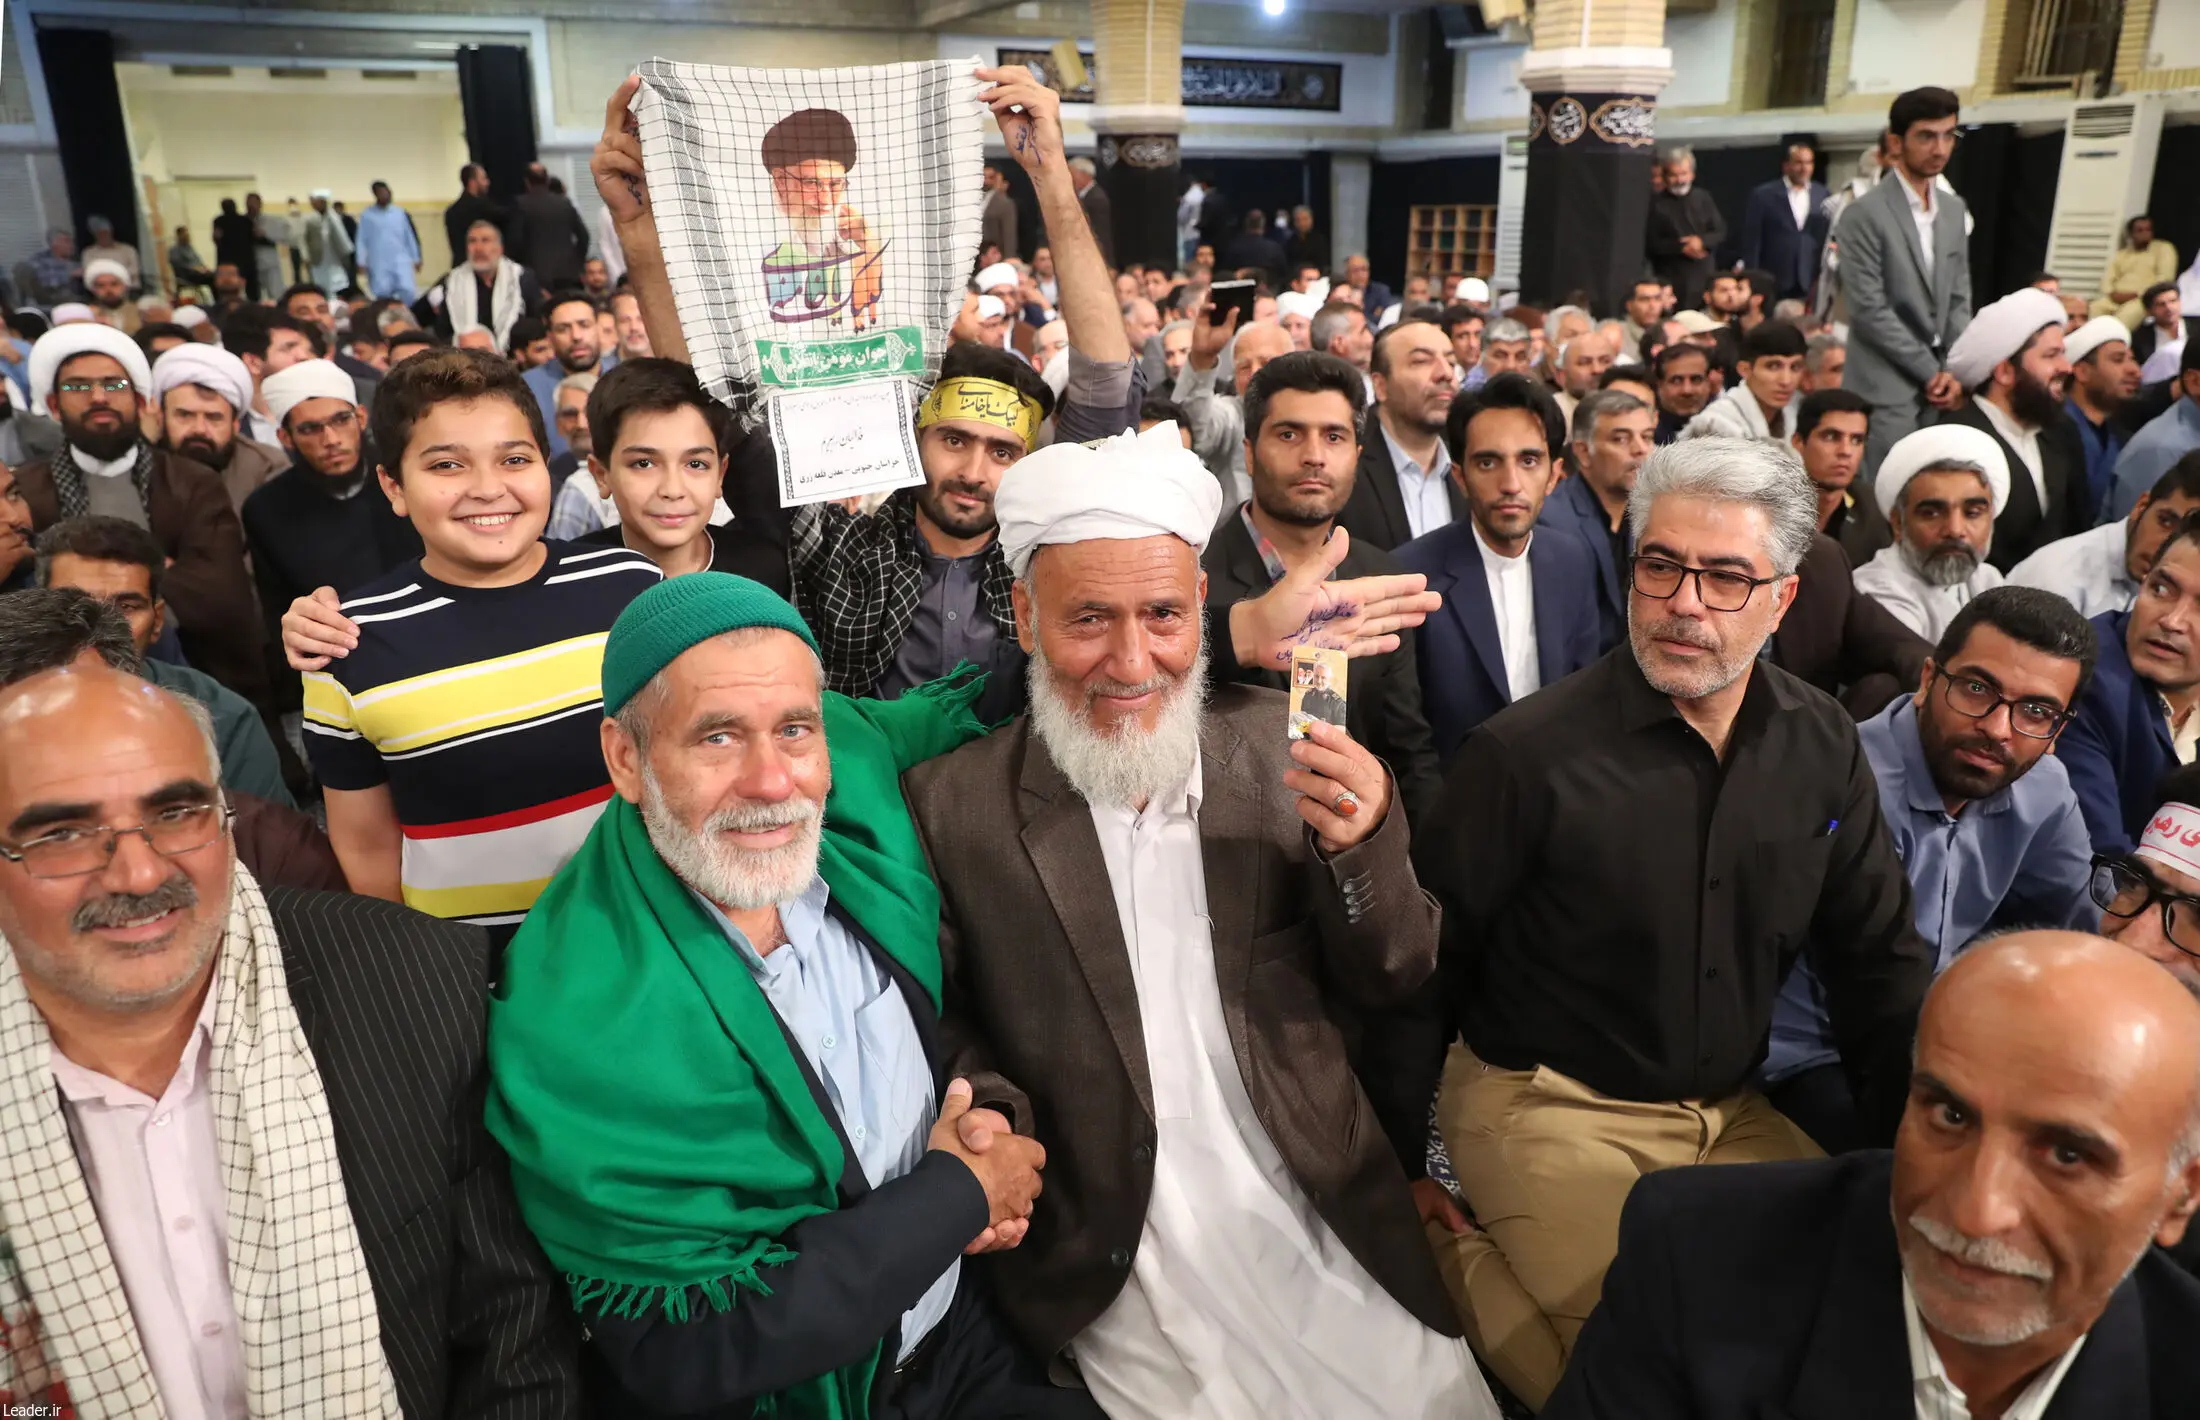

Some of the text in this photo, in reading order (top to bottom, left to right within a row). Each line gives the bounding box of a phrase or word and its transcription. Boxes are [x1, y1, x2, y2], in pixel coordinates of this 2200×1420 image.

[855, 346, 887, 366] جوان
[986, 399, 1019, 427] لبیک
[851, 463, 873, 475] جنوبی
